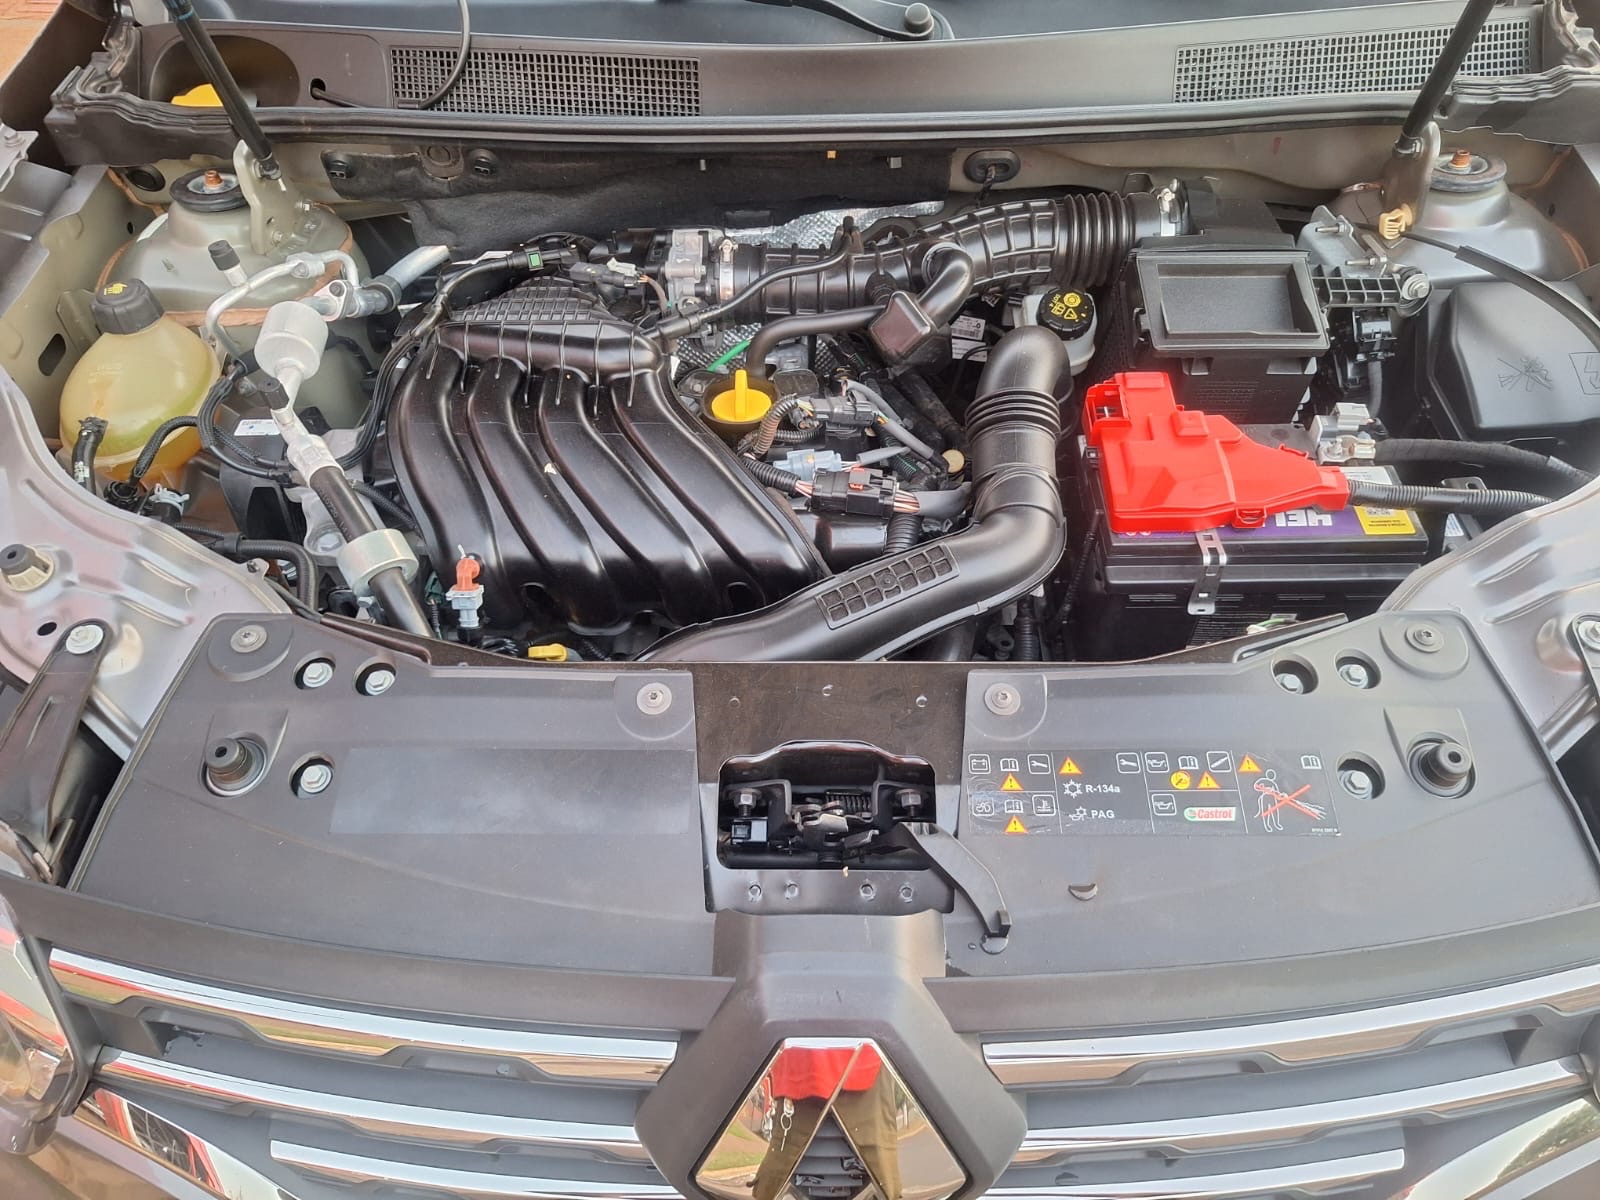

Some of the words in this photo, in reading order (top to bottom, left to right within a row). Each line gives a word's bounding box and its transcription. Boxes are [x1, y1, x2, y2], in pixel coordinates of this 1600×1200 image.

[1086, 785, 1120, 793] R-134a
[1090, 809, 1115, 818] PAG
[1197, 808, 1232, 819] Castrol
